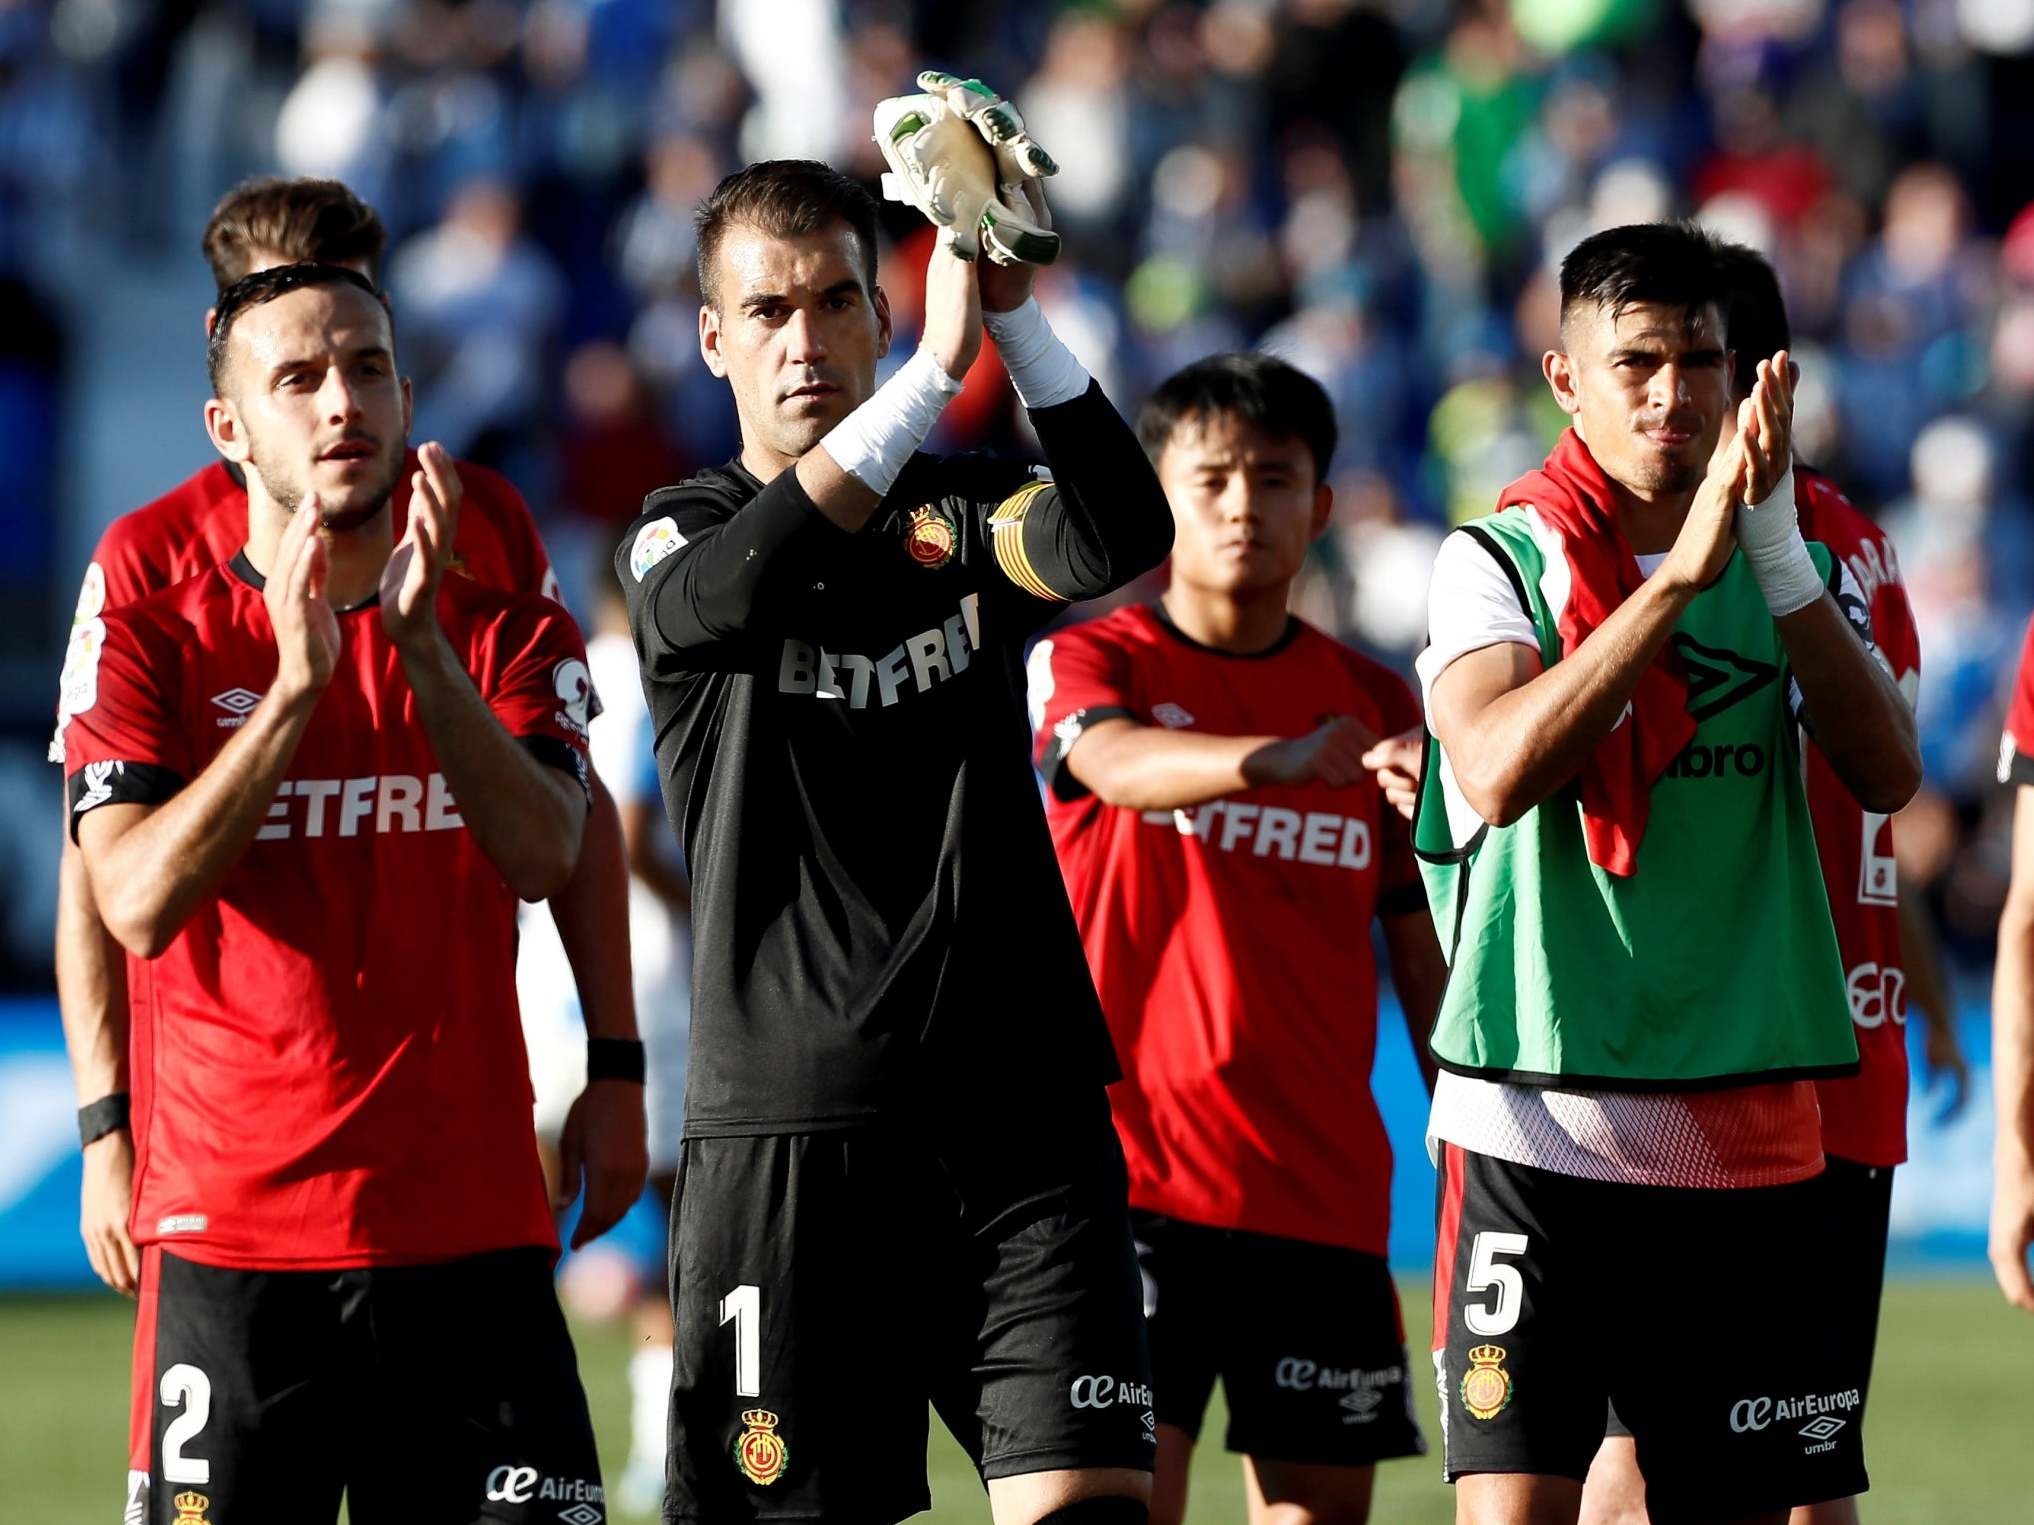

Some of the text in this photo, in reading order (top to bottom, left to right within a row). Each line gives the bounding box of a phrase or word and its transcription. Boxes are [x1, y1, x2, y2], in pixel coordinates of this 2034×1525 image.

[1665, 742, 1765, 779] bro
[1141, 799, 1372, 871] TFRED
[1464, 1231, 1529, 1336] 5
[719, 1284, 760, 1398] 1
[159, 1363, 211, 1485] 2
[1775, 1388, 1860, 1420] AirEuropa
